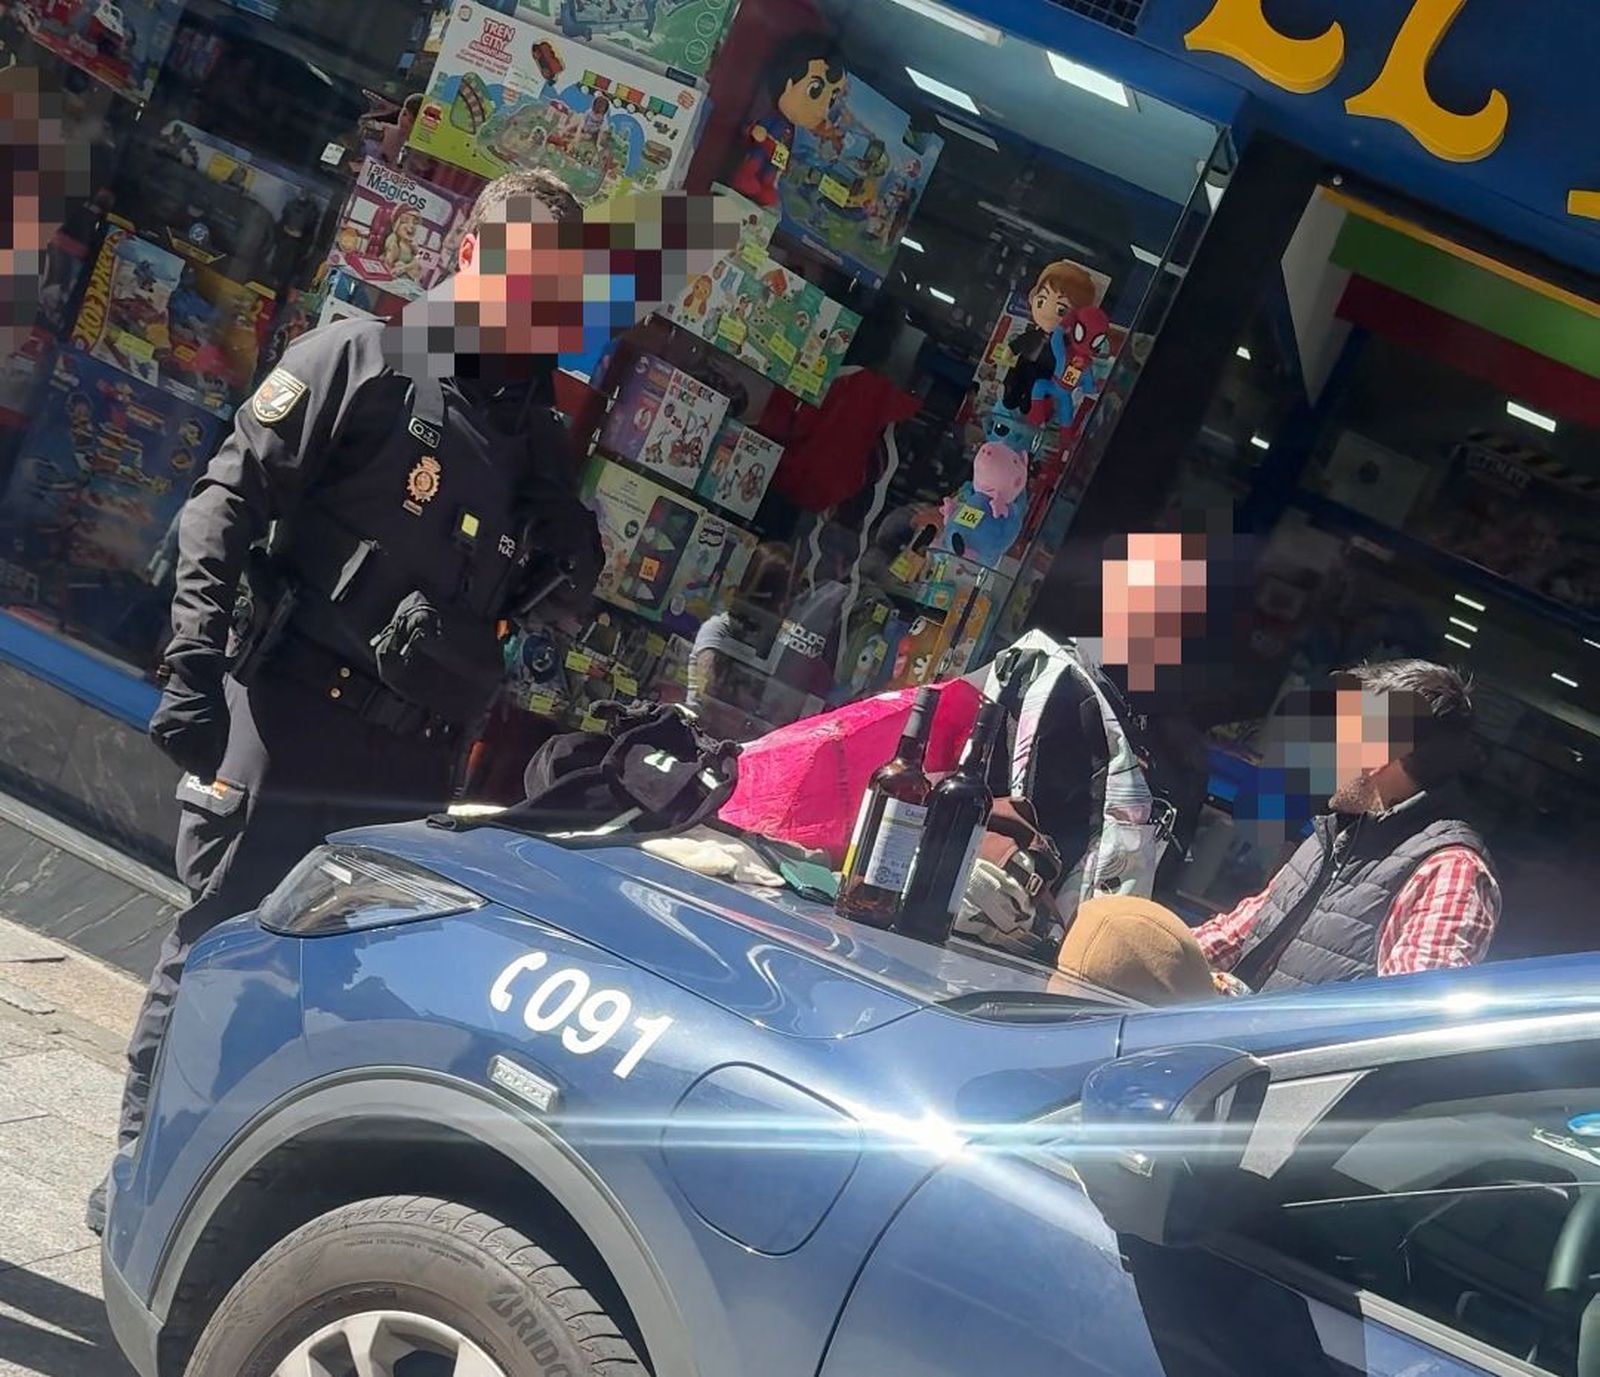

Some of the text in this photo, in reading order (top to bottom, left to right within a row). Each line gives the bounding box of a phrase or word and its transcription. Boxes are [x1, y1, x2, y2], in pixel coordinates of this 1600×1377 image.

[483, 17, 516, 40] TREN
[480, 32, 507, 50] CITY
[524, 968, 675, 1079] 091
